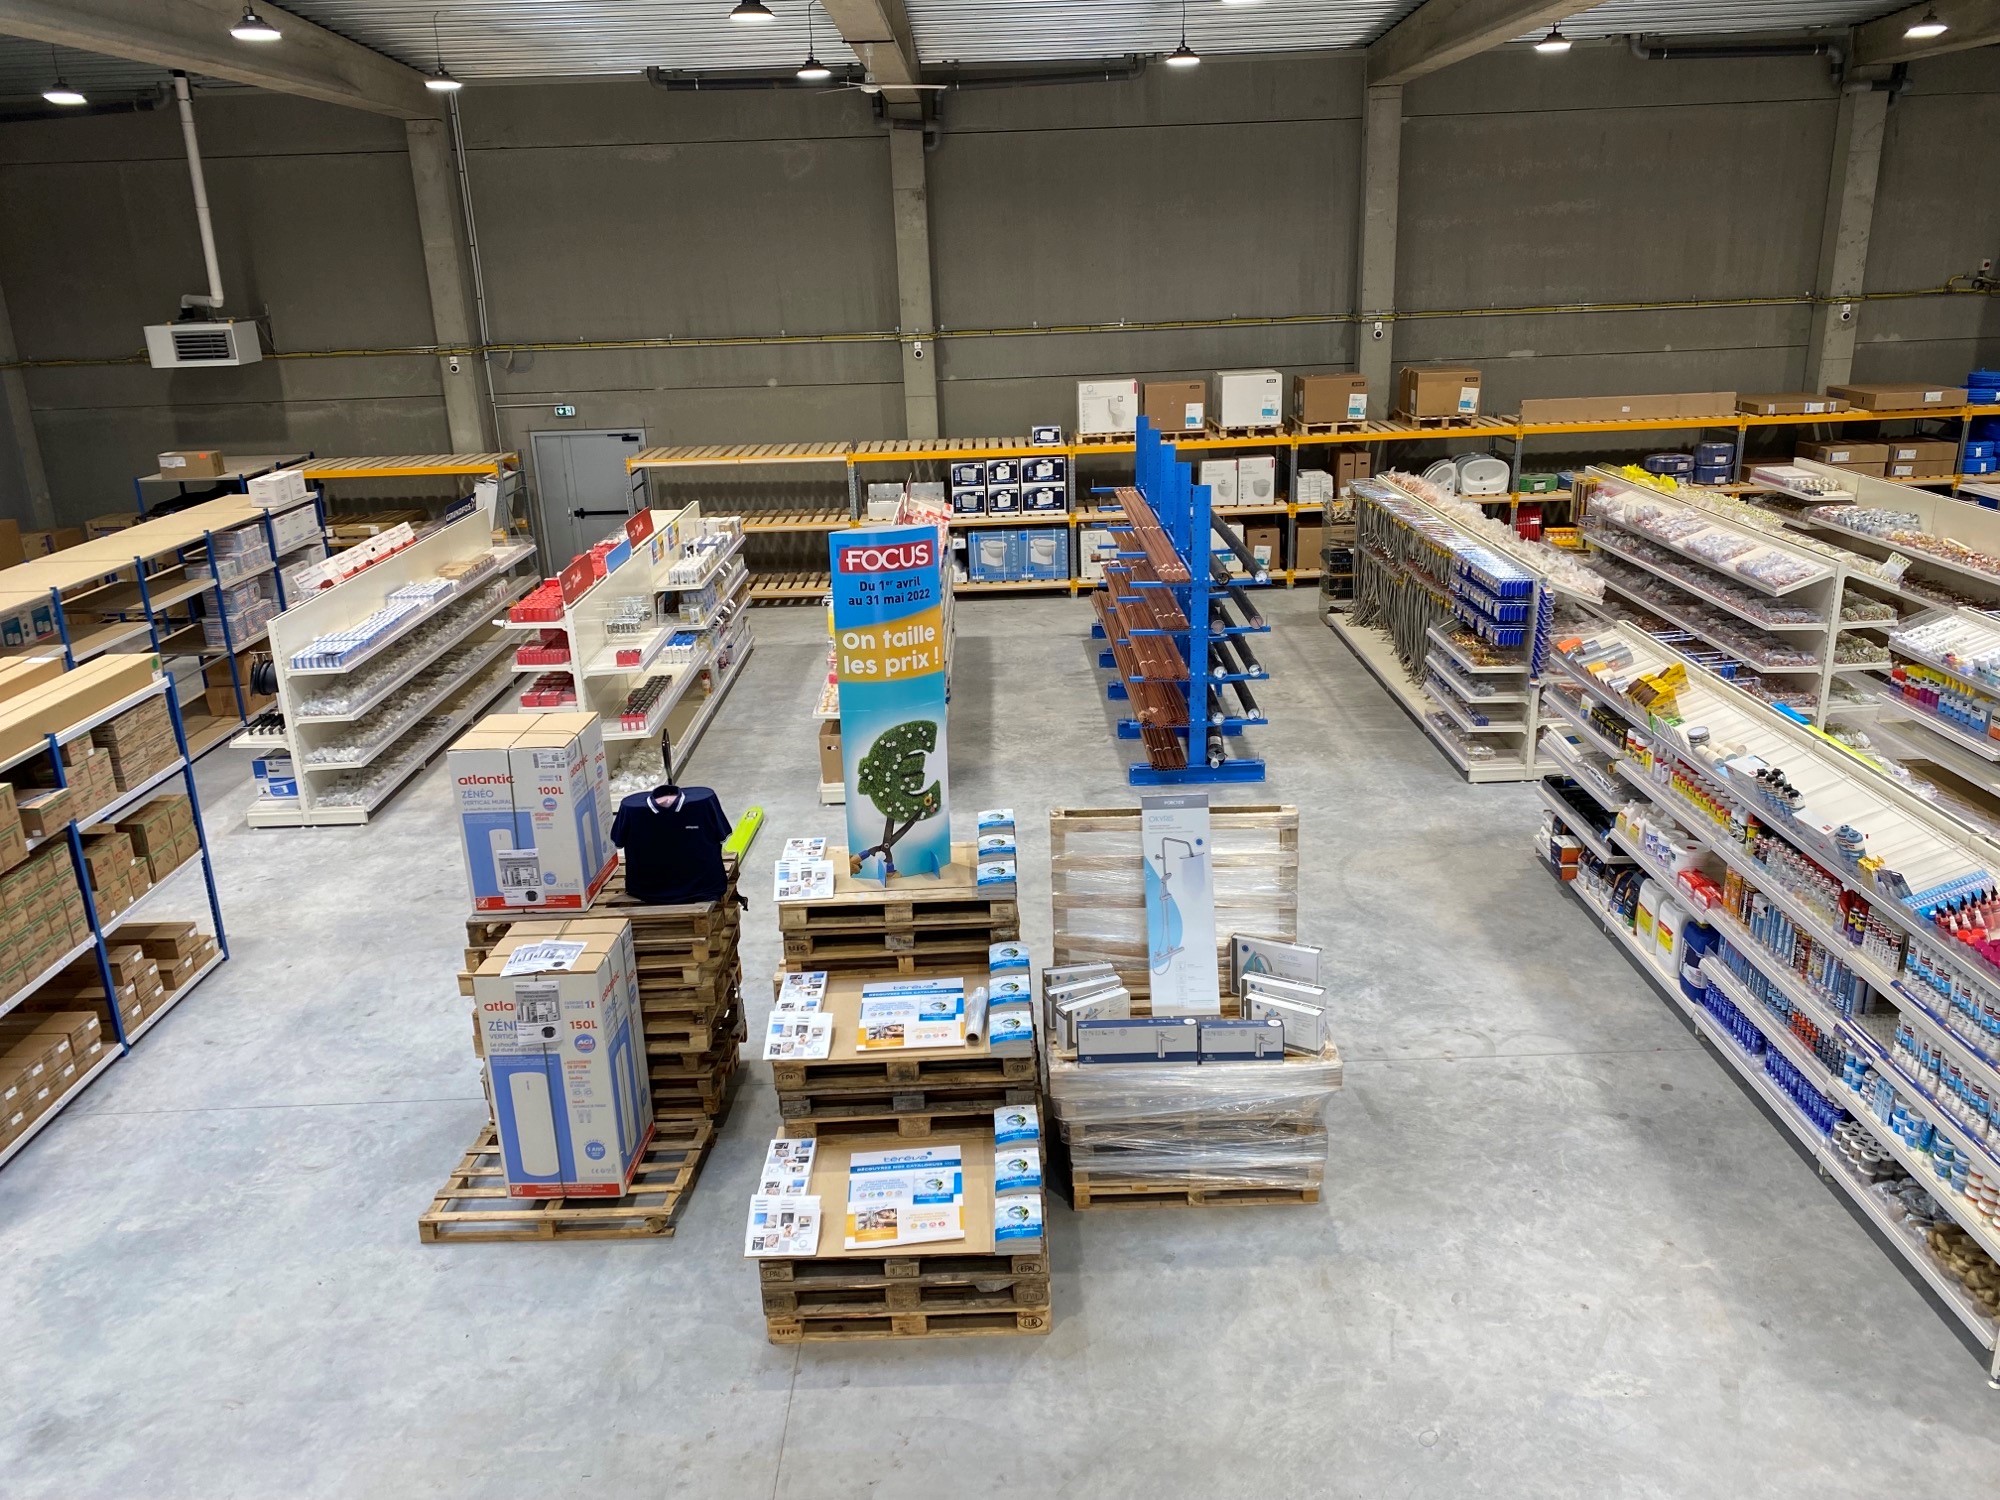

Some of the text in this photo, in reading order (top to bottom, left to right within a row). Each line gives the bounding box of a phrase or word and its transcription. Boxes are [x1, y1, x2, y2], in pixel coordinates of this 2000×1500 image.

[846, 544, 929, 571] FOCUS
[859, 581, 875, 592] Du
[896, 576, 920, 589] avril
[848, 588, 930, 606] au 31 mai 2022
[842, 624, 936, 650] On taille
[844, 655, 878, 674] les
[885, 650, 929, 677] prix
[458, 773, 515, 786] atlantic
[461, 788, 494, 799] ZÉNÉO
[537, 786, 564, 795] 100L
[569, 1020, 598, 1030] 150L
[1023, 1318, 1038, 1327] EUR
